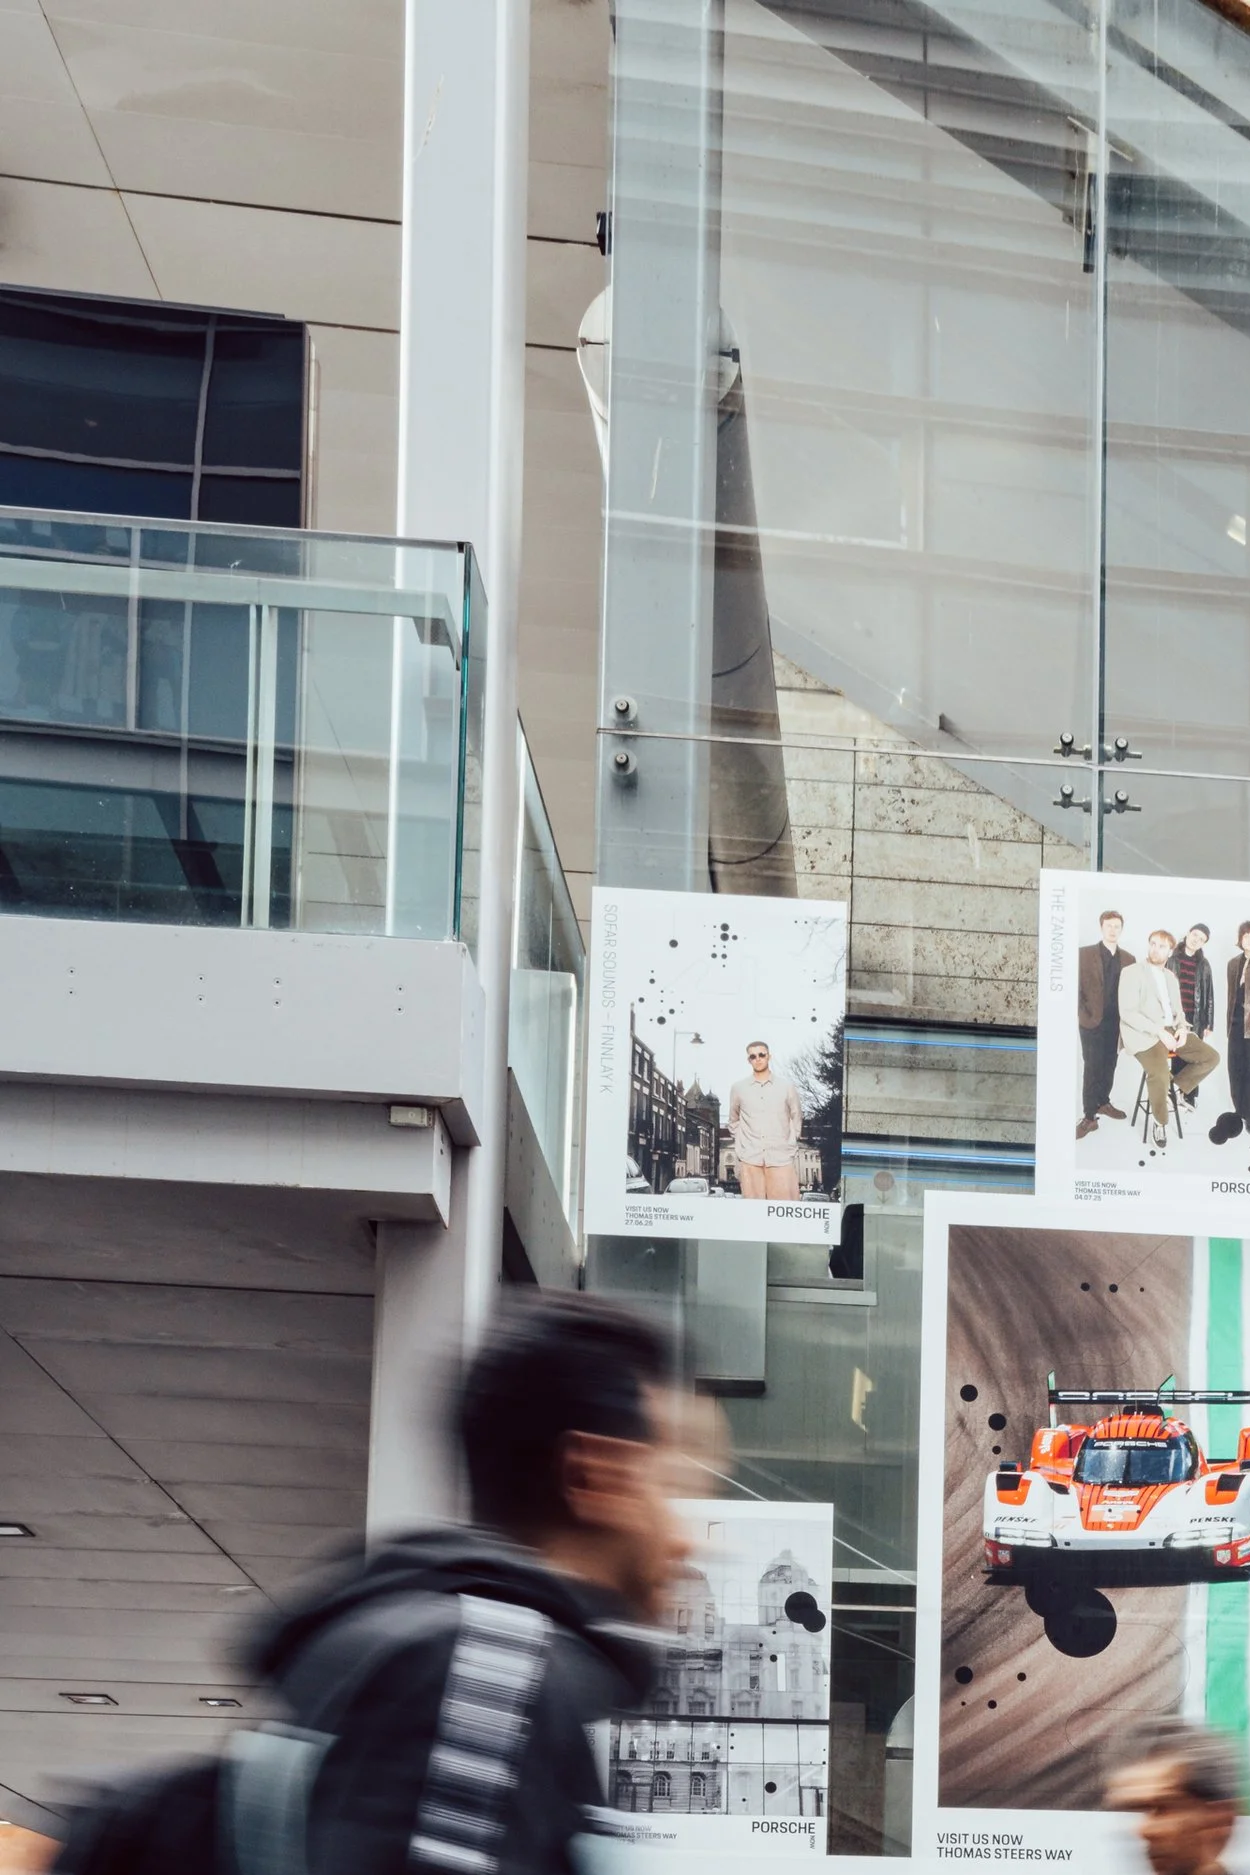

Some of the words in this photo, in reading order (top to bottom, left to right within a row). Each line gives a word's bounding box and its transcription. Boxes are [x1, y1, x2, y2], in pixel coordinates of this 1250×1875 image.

[1051, 886, 1065, 912] THE
[603, 904, 618, 948] SOFAR
[1050, 916, 1065, 992] ZANGWILLS
[602, 951, 616, 1008] SOUNDS
[601, 1025, 615, 1082] FINNLAY
[768, 1206, 829, 1219] PORSCHE
[1189, 1516, 1237, 1524] PENSKE
[752, 1822, 815, 1834] PORSCHE
[937, 1833, 969, 1844] VISIT
[973, 1834, 988, 1844] US
[993, 1834, 1023, 1845] NOW
[937, 1847, 991, 1859] THOMAS
[995, 1848, 1041, 1860] STEERS
[1045, 1849, 1072, 1860] WAY
